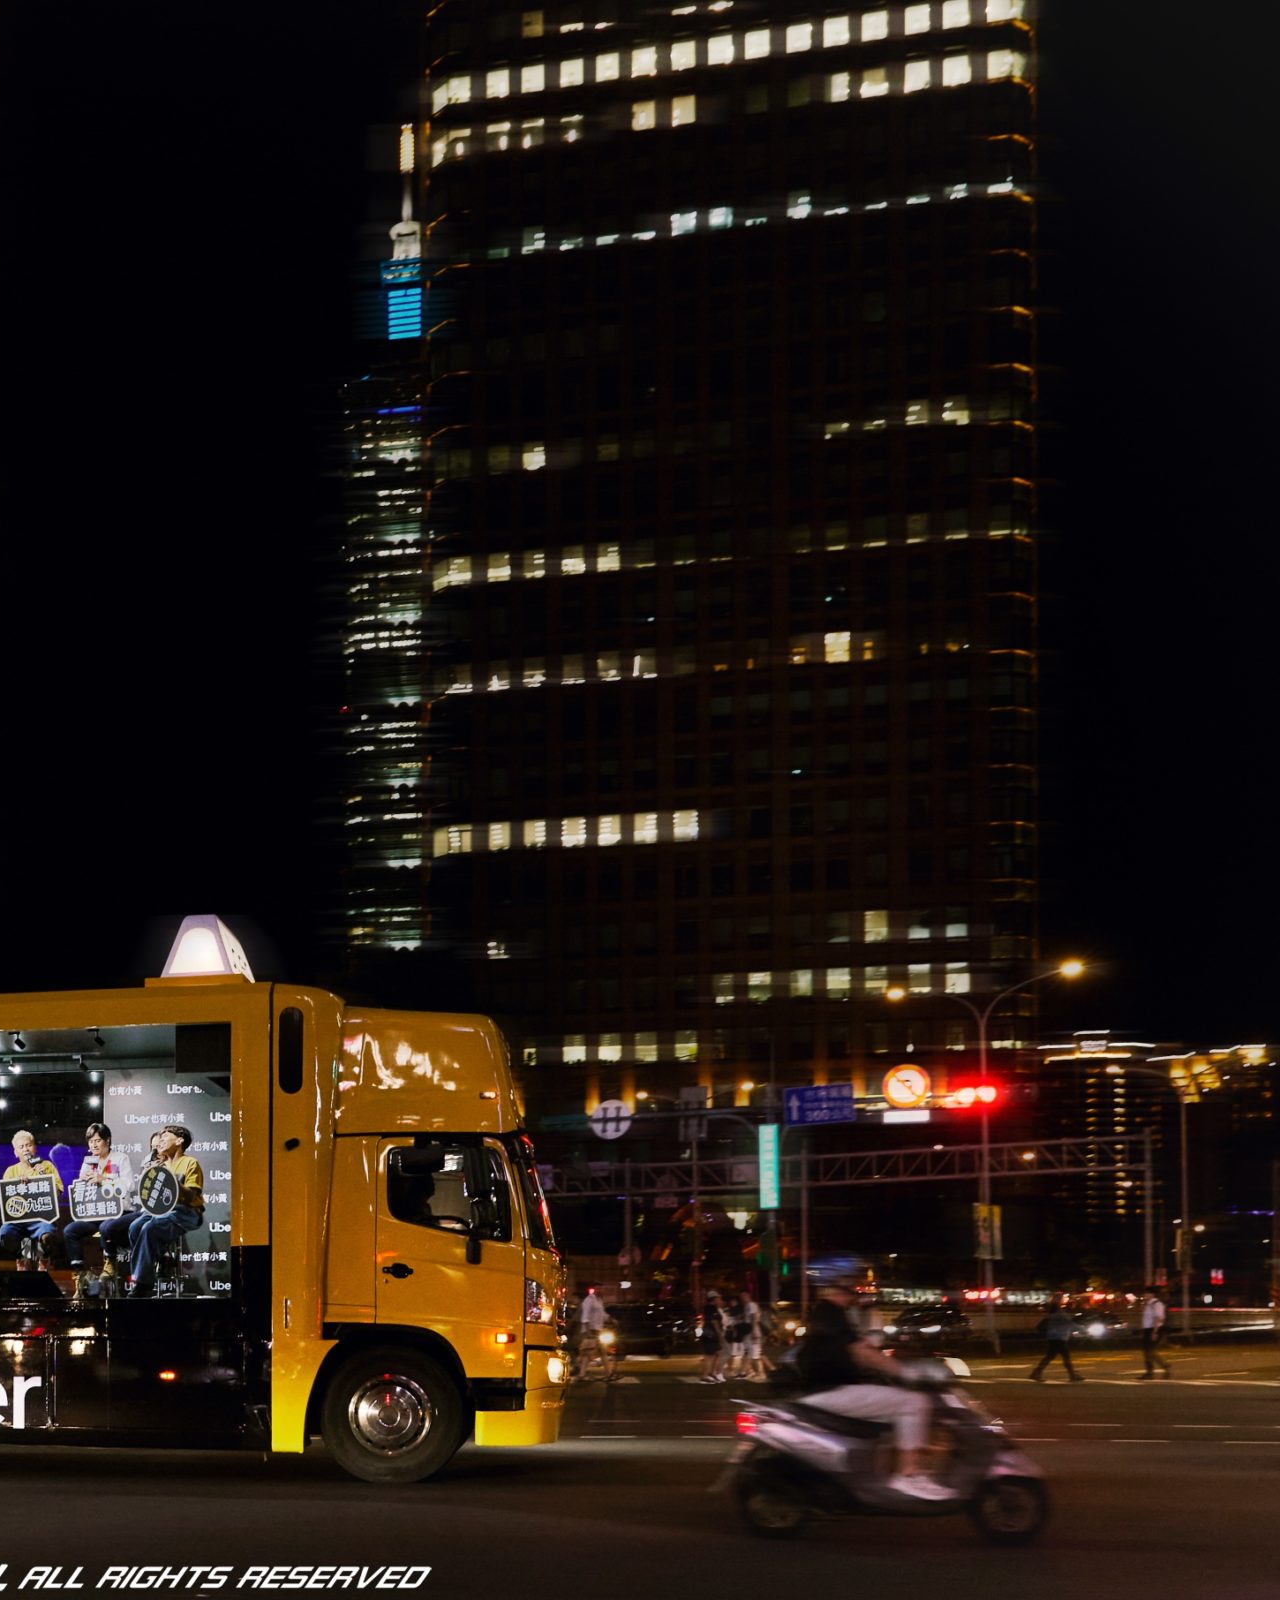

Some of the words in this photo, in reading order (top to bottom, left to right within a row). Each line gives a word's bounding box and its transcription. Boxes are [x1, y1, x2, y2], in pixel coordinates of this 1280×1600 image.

[108, 1085, 142, 1096] 也有小黃
[167, 1084, 192, 1094] Uber
[125, 1113, 149, 1124] Uber
[151, 1112, 185, 1124] 也有小黃
[194, 1141, 228, 1152] 也有小黃
[5, 1180, 51, 1197] 忠孝東路
[76, 1201, 118, 1217] 也要看路
[193, 1251, 228, 1262] 也有小黃
